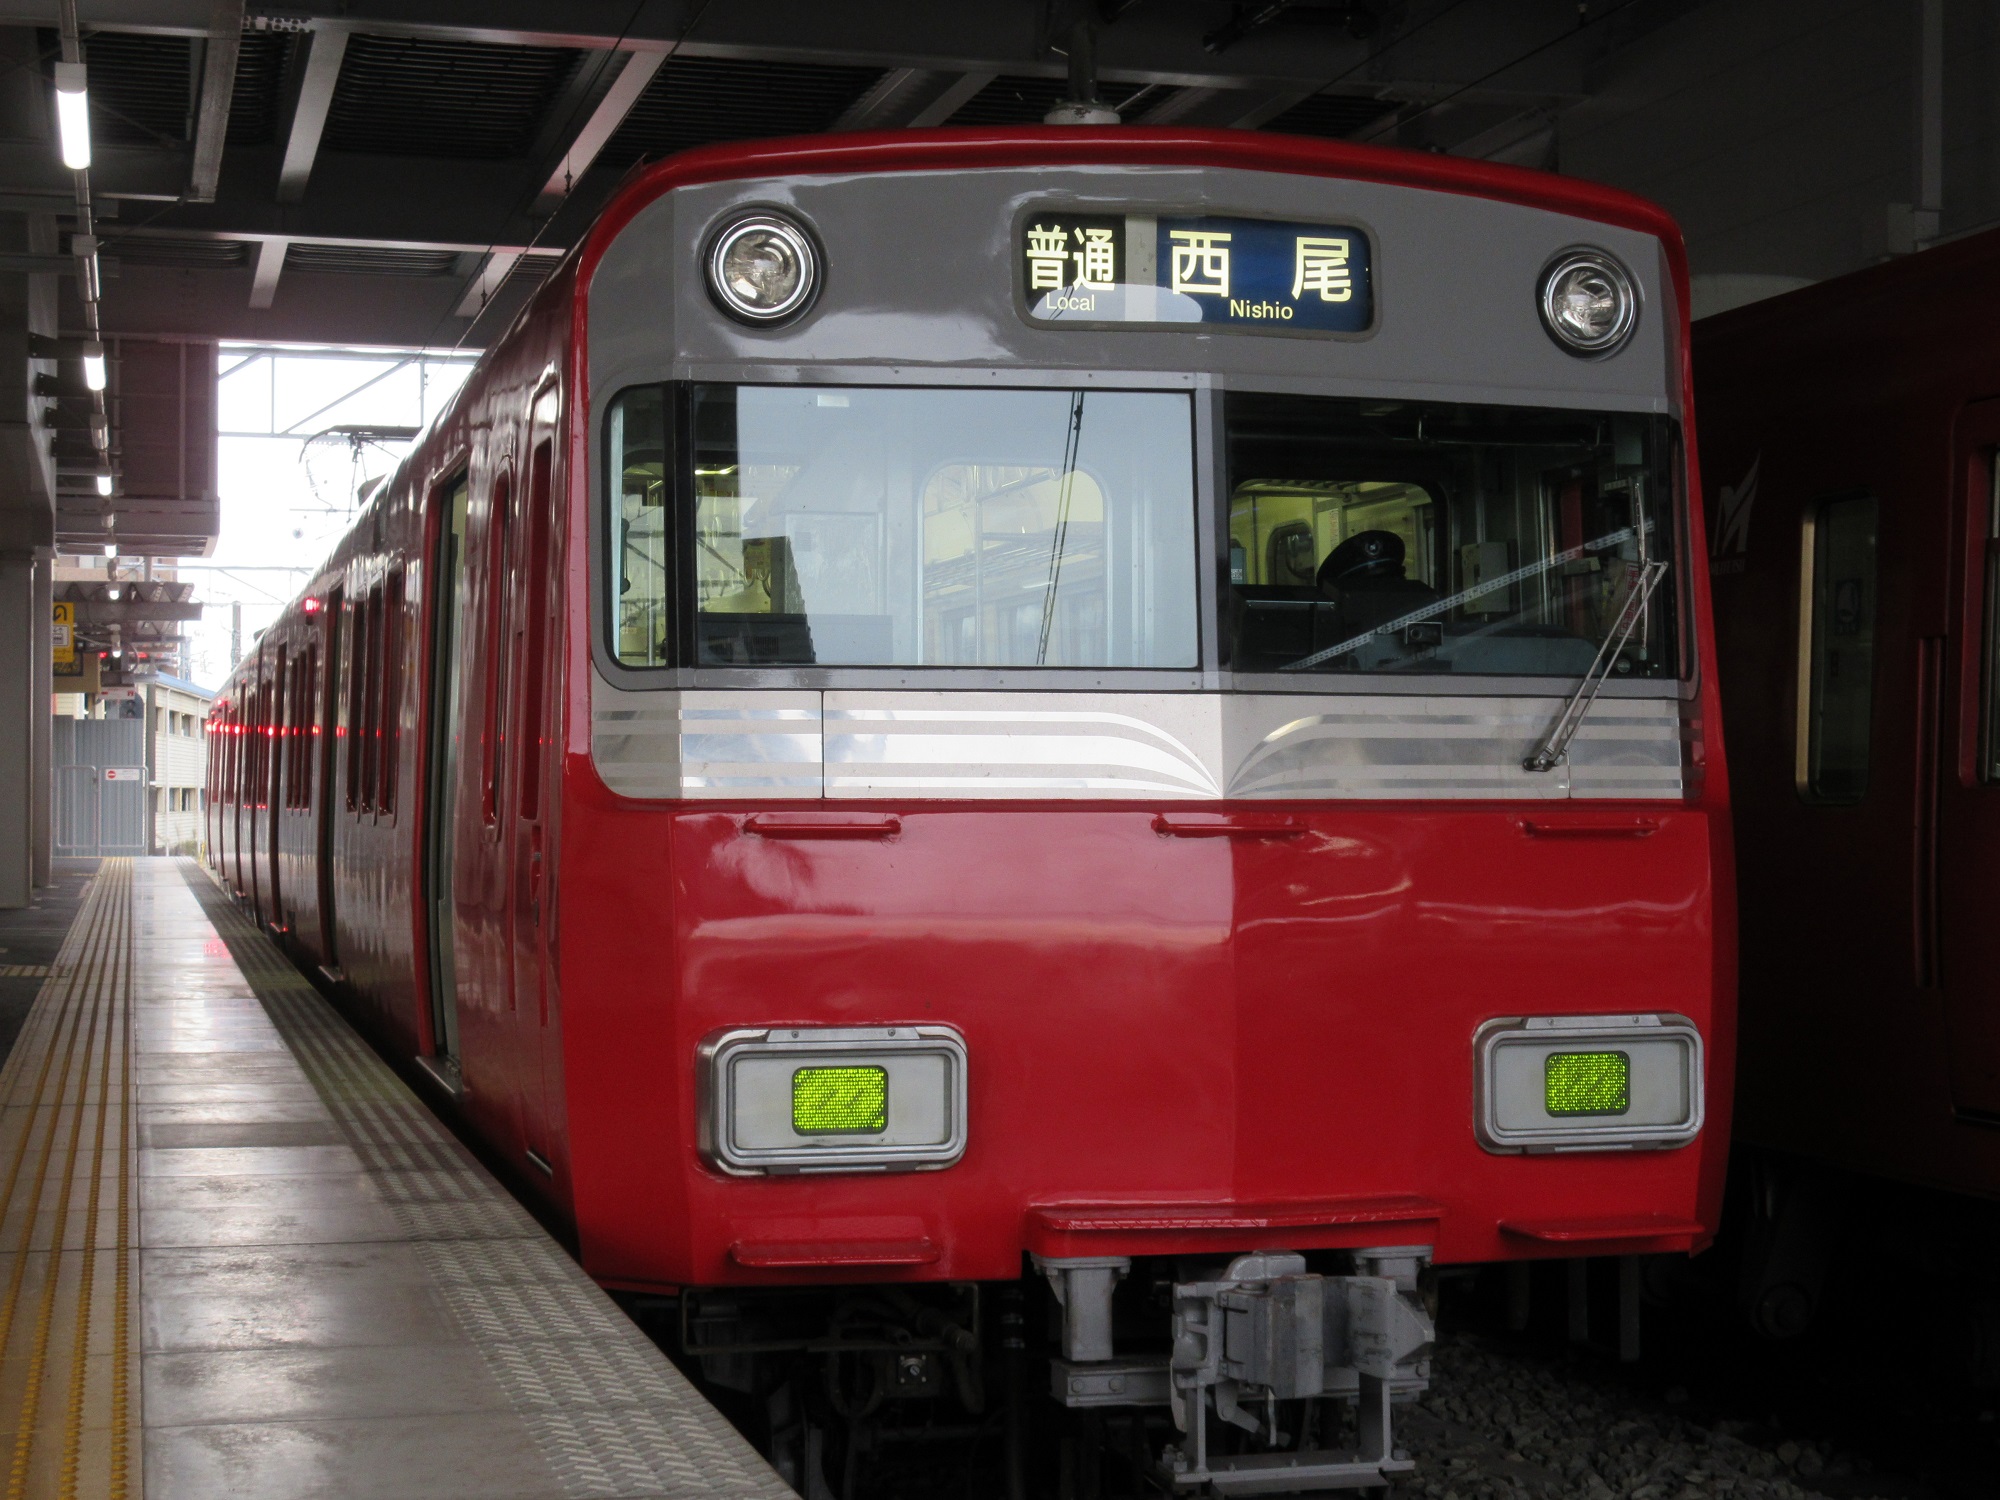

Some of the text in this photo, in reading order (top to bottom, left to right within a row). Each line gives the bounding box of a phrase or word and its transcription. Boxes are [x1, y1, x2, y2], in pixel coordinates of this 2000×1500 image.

[1026, 224, 1115, 291] 普通
[1170, 230, 1352, 303] 西尾
[1046, 292, 1095, 311] Local
[1230, 299, 1294, 320] Nishio
